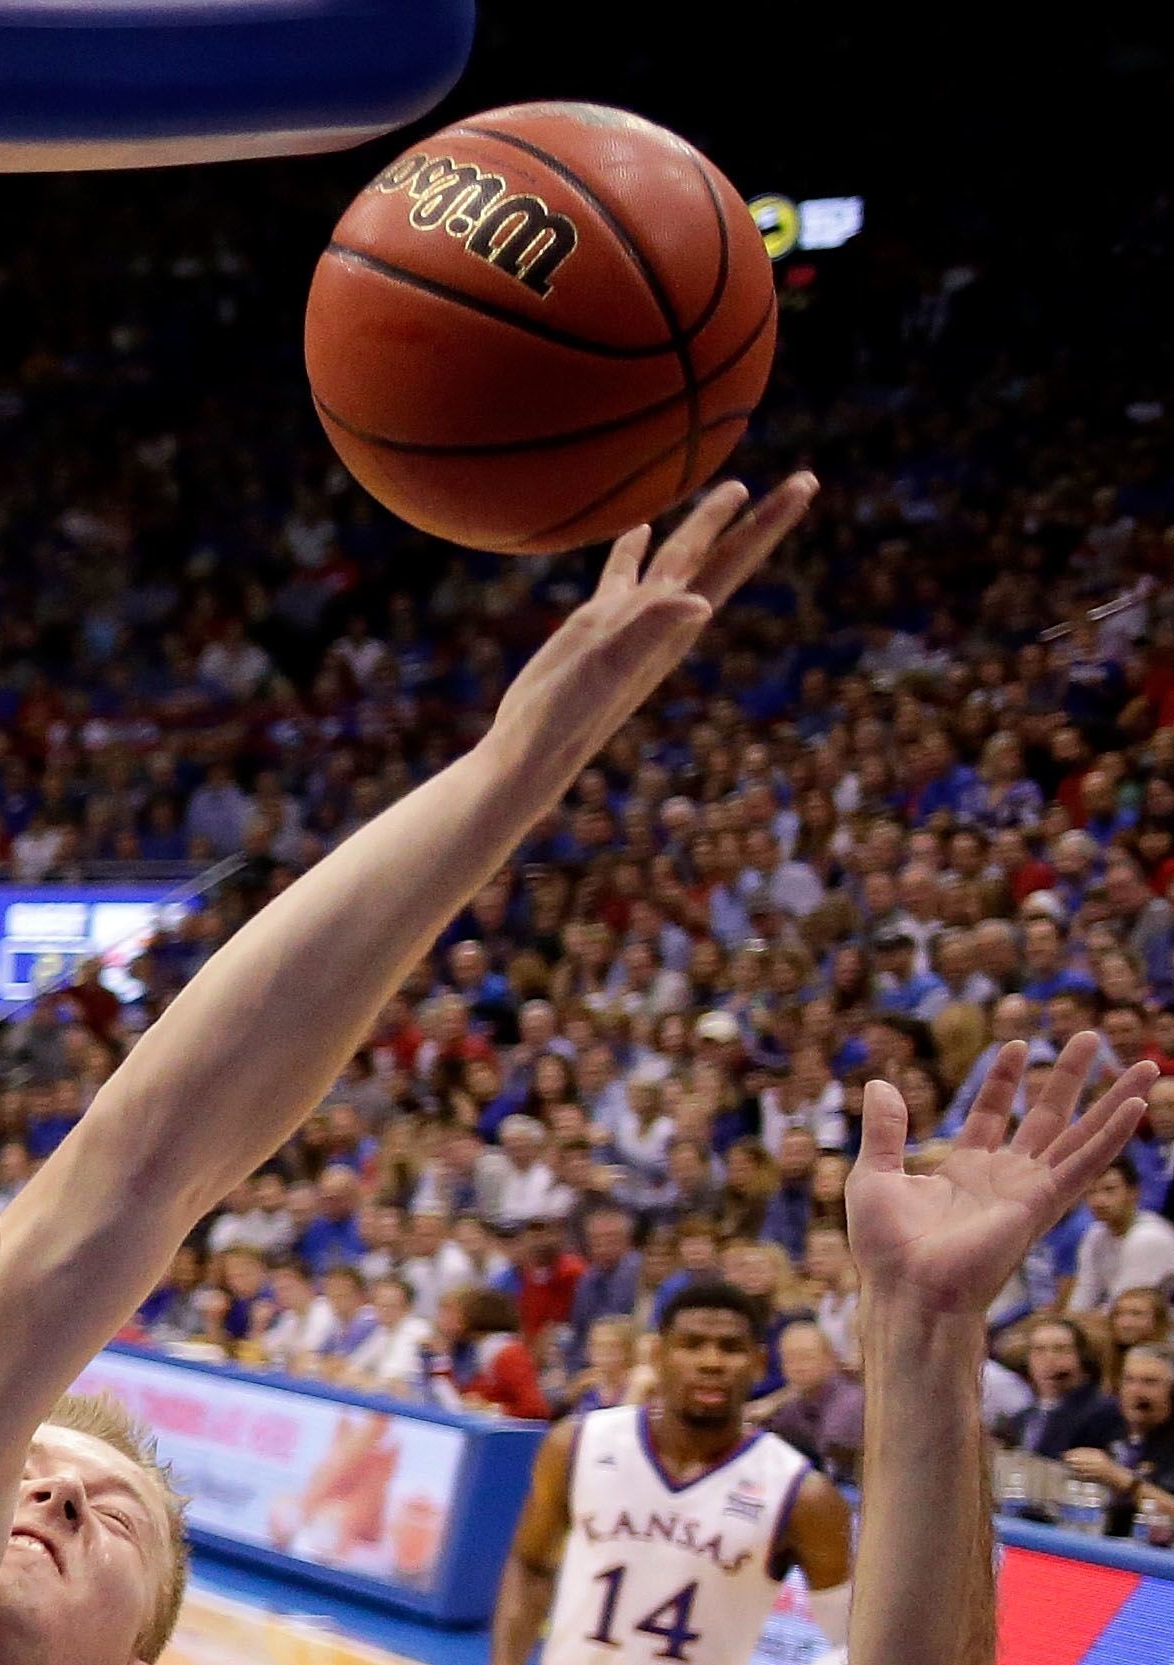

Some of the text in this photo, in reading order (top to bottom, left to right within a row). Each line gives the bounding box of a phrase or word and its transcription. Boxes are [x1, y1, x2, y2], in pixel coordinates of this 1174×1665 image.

[367, 153, 578, 300] Wilso
[579, 1511, 752, 1573] KANSAS
[584, 1563, 702, 1664] 14
